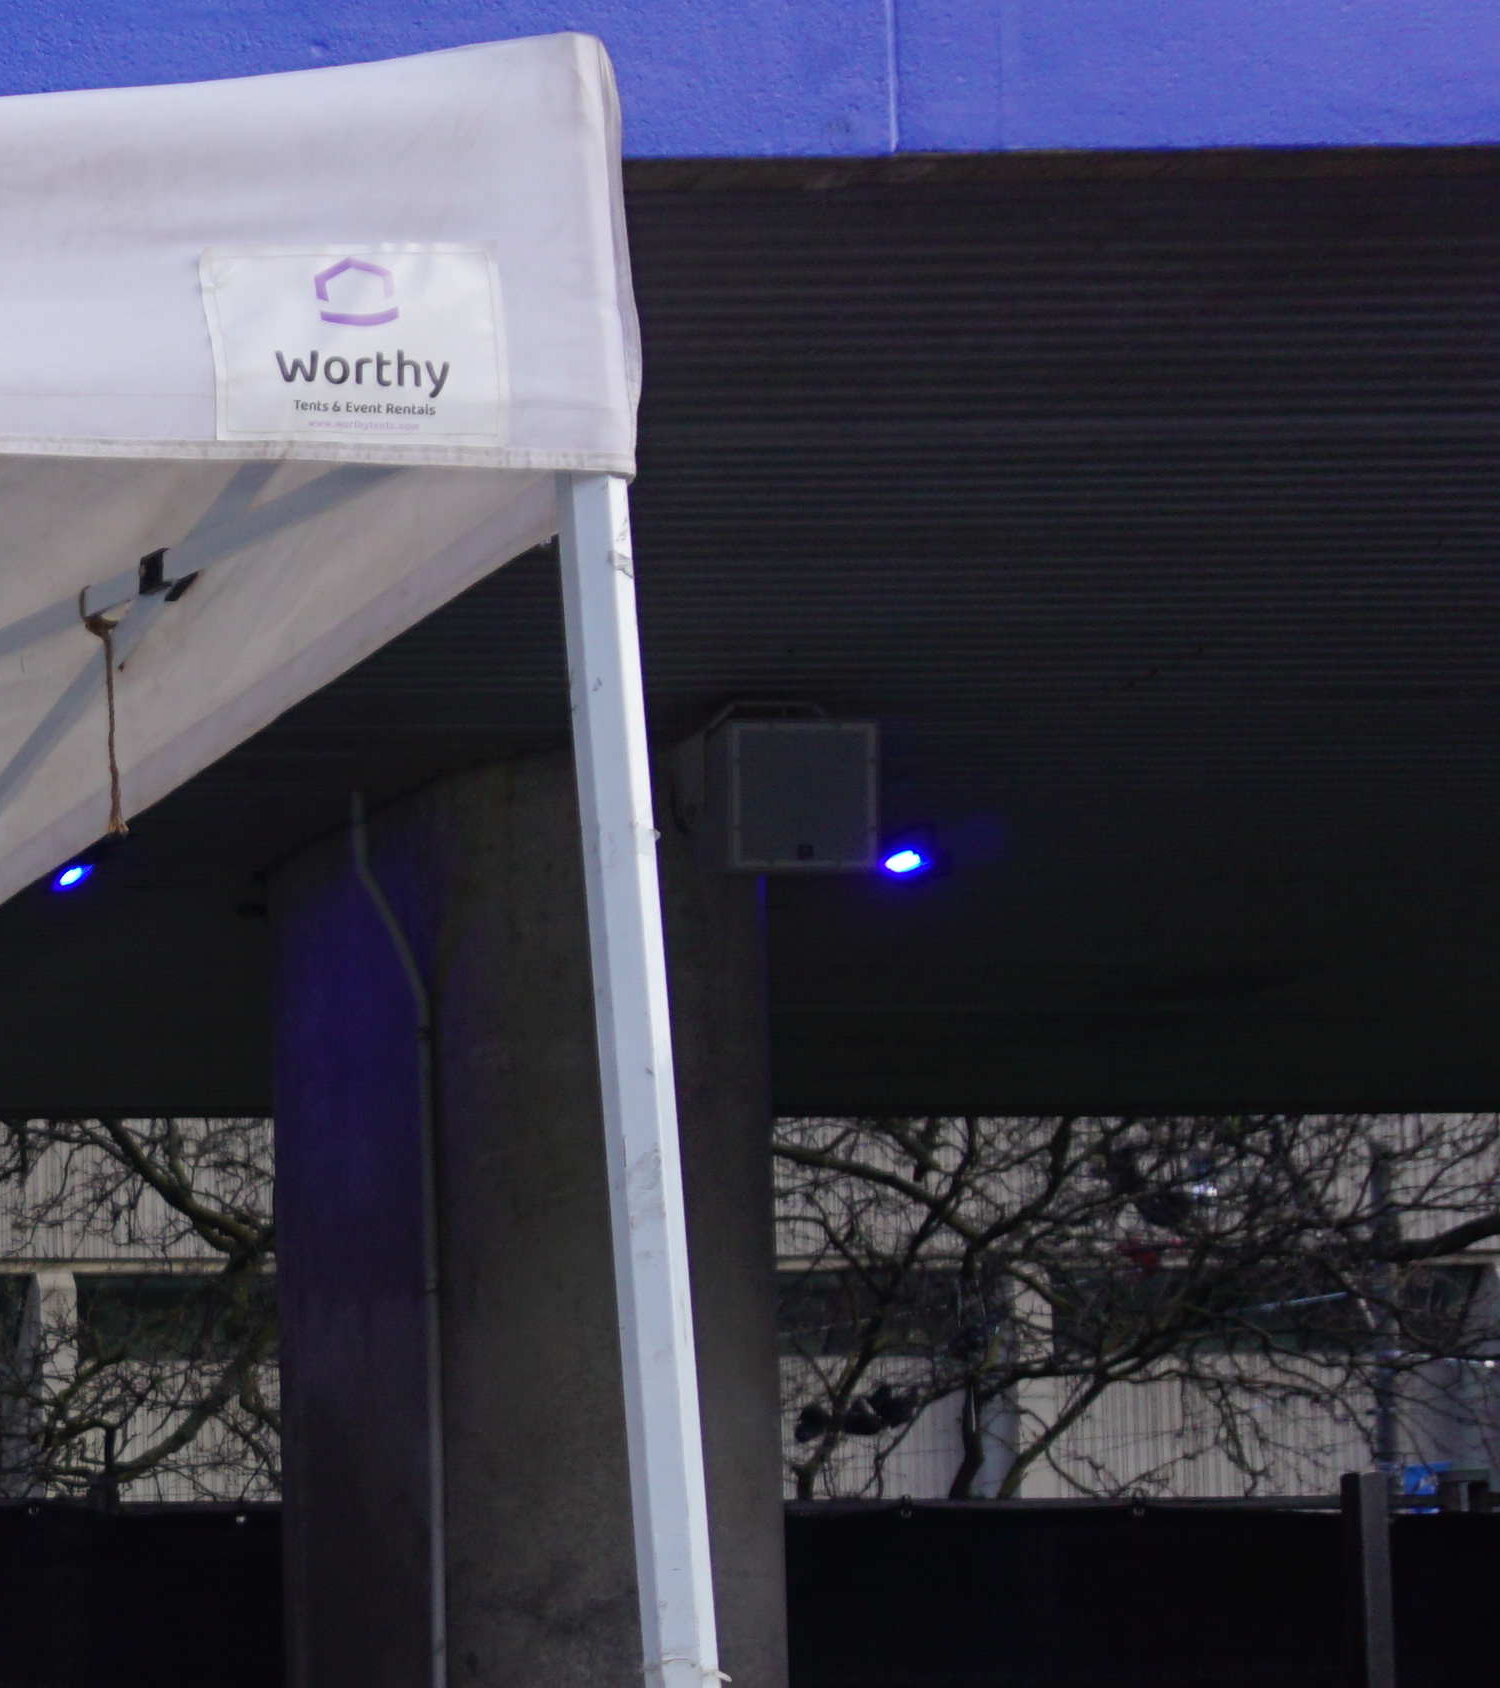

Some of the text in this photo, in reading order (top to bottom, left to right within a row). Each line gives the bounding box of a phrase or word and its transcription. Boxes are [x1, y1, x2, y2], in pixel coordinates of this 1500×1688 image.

[275, 348, 450, 398] Worthy
[294, 400, 437, 416] Tents & Event Rentals
